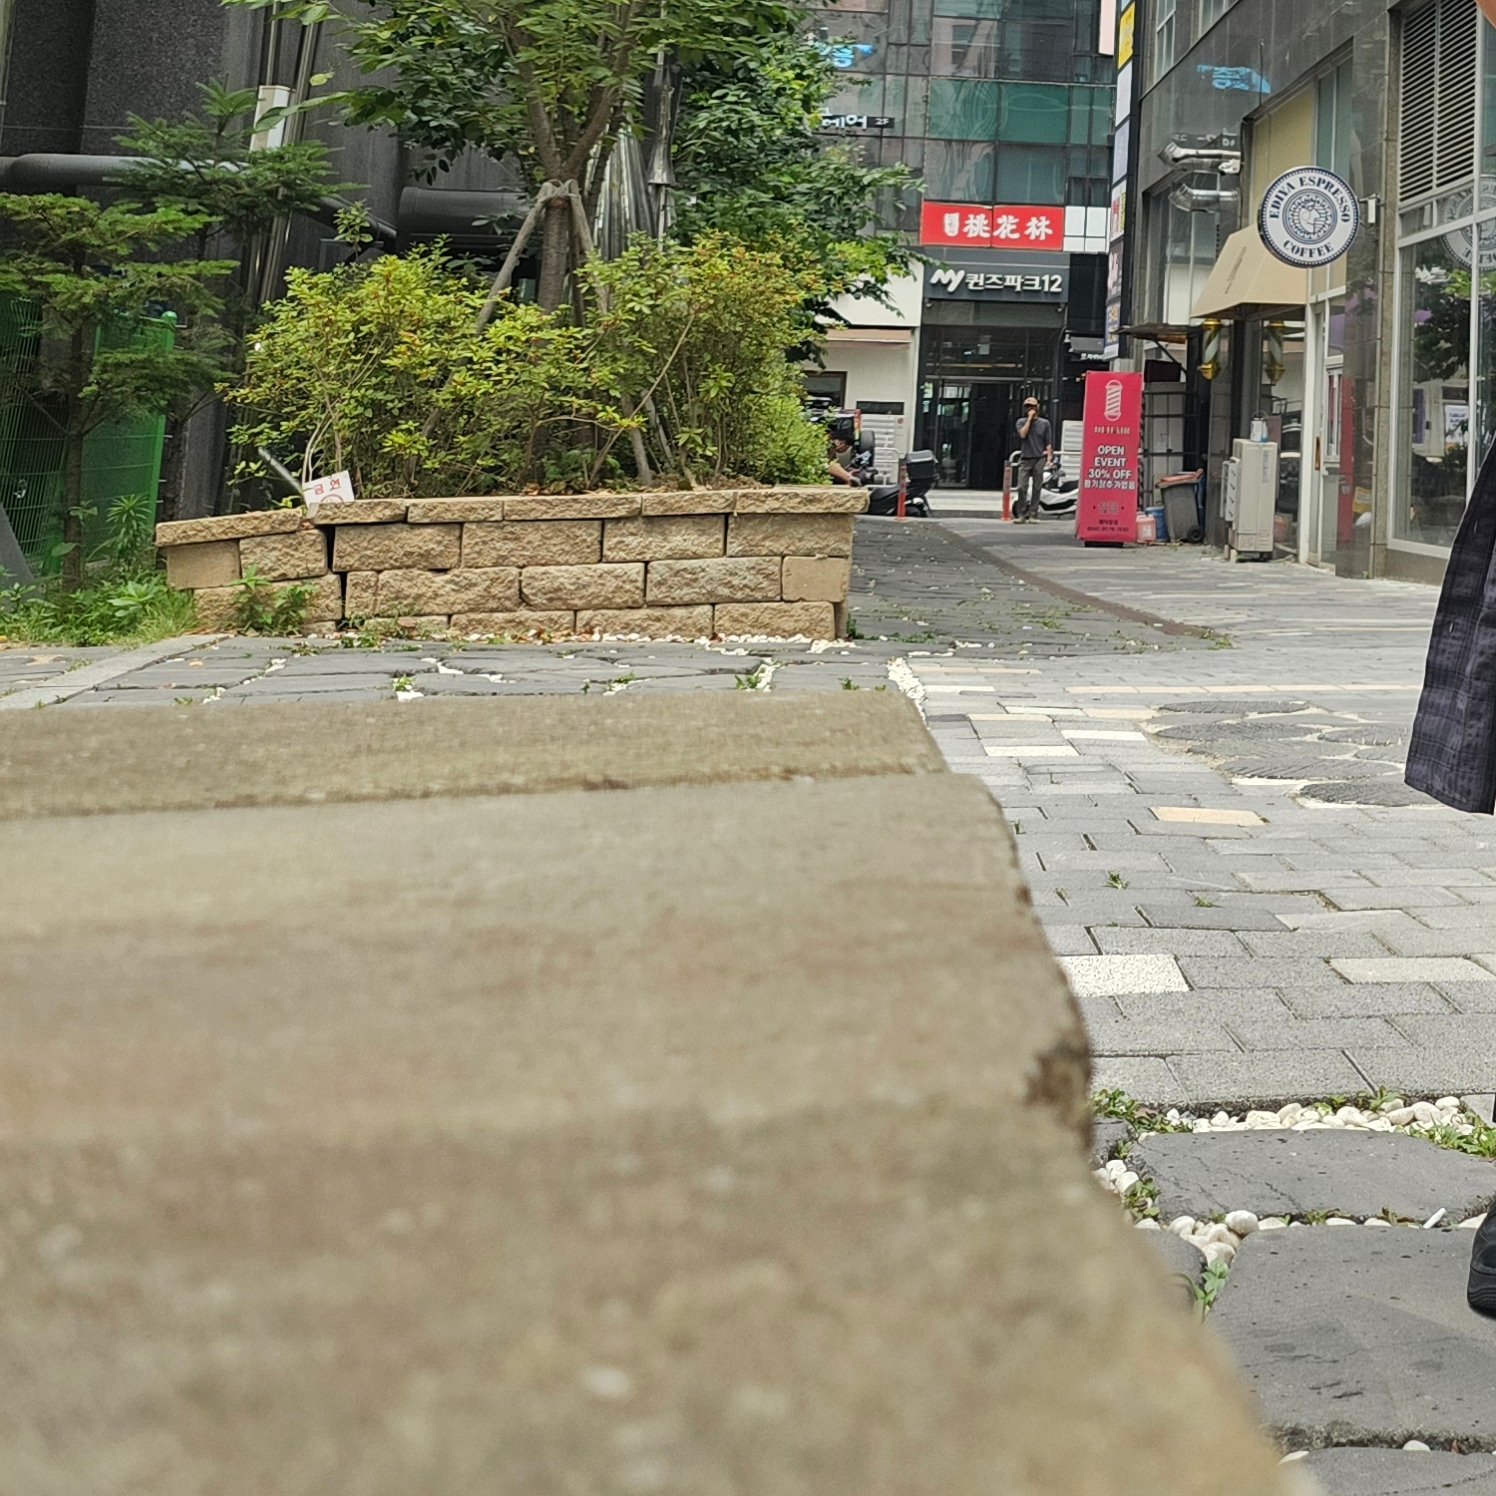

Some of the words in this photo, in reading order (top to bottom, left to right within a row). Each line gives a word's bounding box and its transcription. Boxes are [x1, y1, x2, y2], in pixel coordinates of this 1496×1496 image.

[1268, 182, 1295, 219] EDIYA
[1299, 176, 1351, 223] ESPRESSO
[963, 213, 1053, 241] 桃花林
[1283, 240, 1334, 258] COFFEE
[1097, 445, 1125, 456] OPEN
[1094, 457, 1126, 468] EVENT
[1088, 468, 1110, 479] 30%
[1113, 469, 1132, 480] OFF
